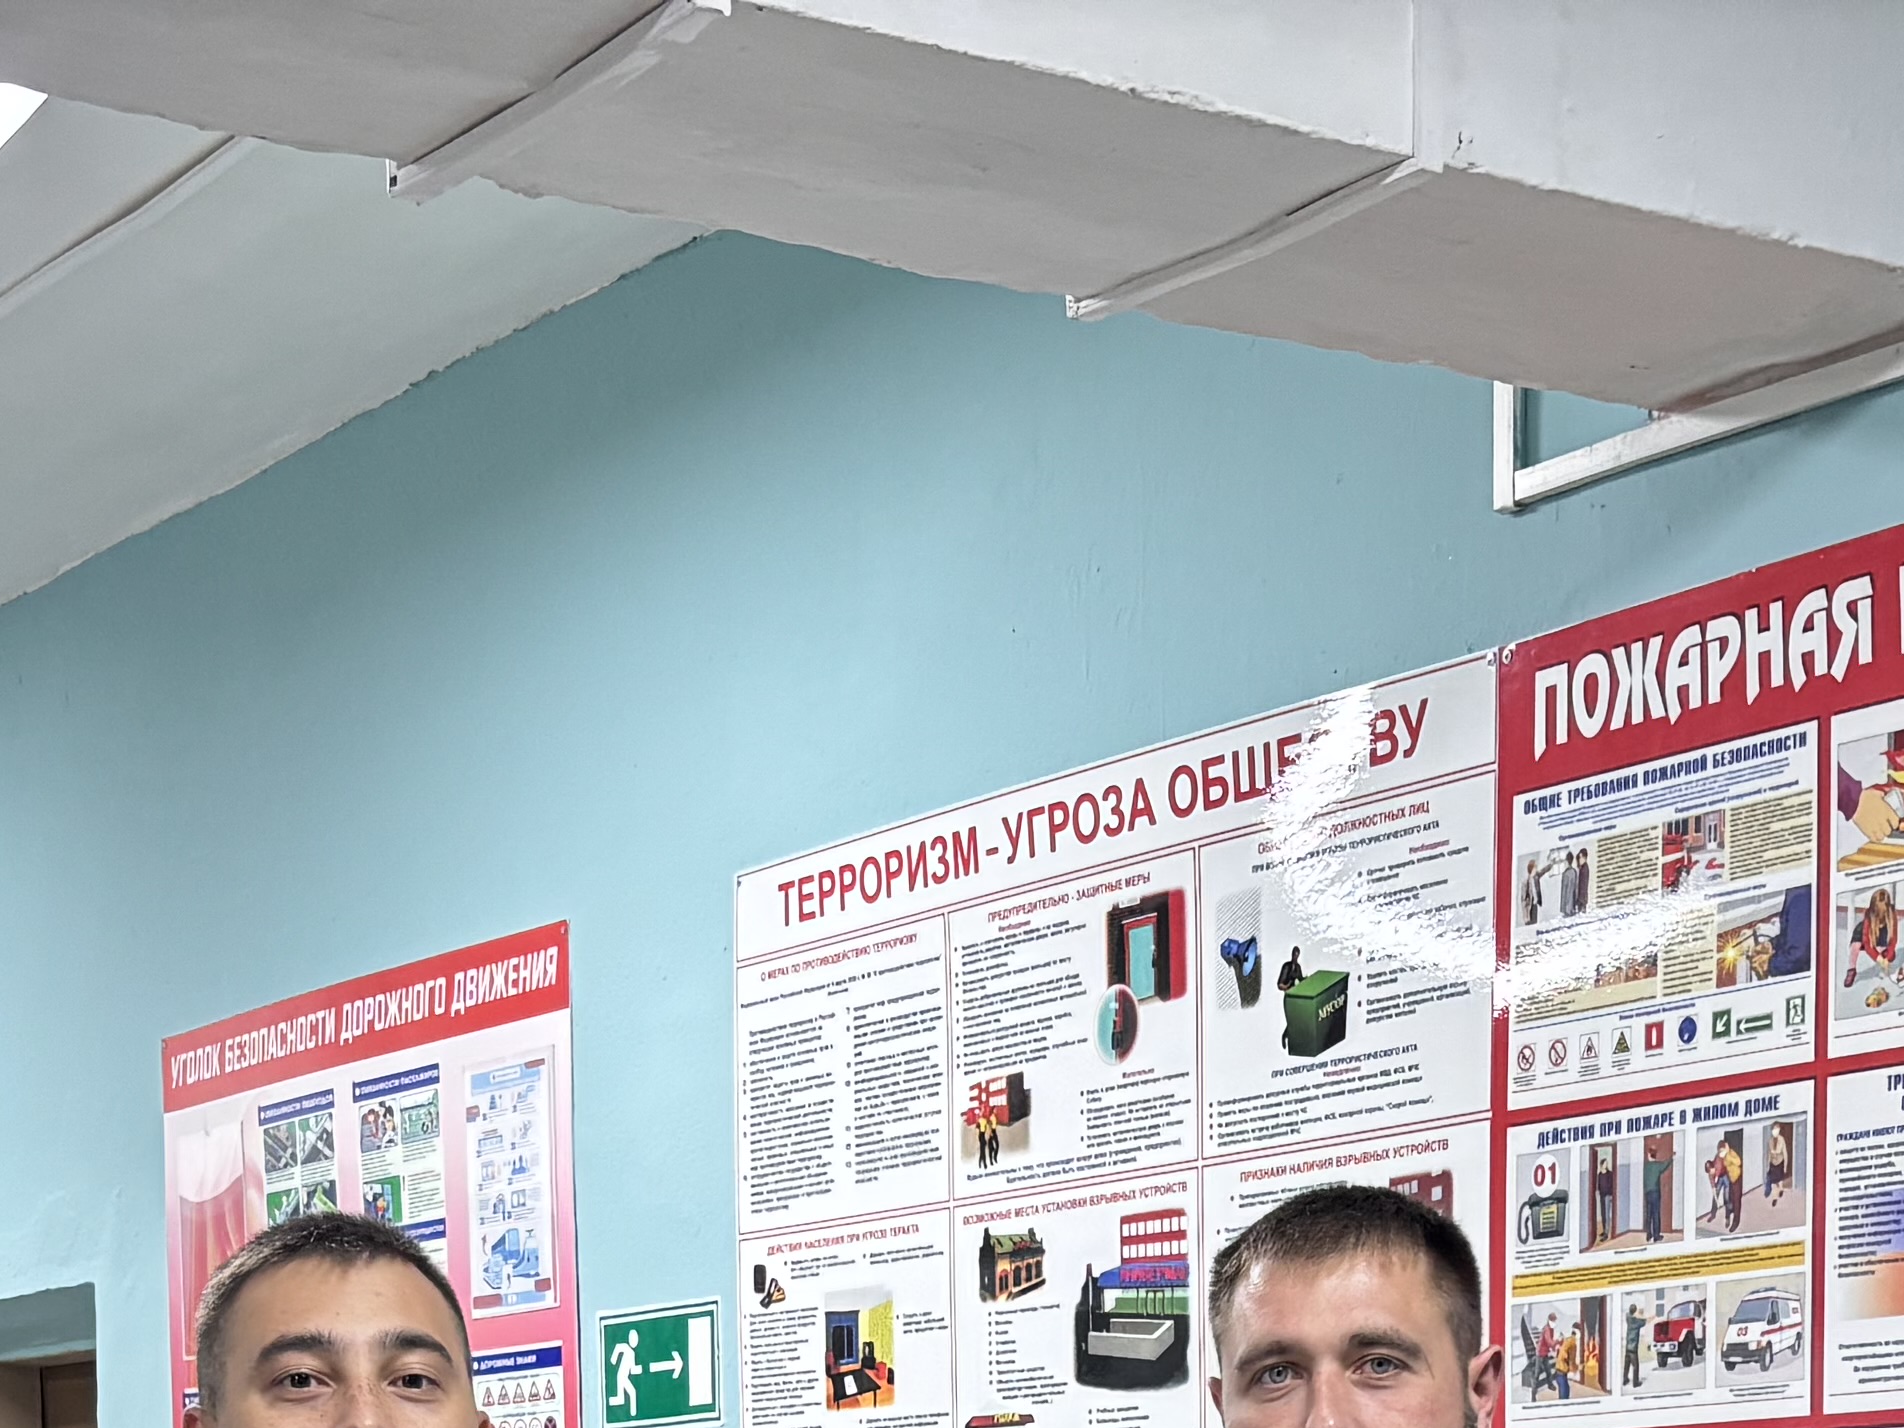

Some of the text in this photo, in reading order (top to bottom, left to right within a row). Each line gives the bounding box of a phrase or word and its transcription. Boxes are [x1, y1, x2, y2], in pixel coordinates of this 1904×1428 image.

[1533, 575, 1875, 762] ПОЖАРНАЯ
[1166, 698, 1429, 820] ОБЩЕВУ
[1524, 731, 1807, 815] ОБЩИЕ ТРЕБОВАНИЯ ПОЖАРНОЙ БЕЗОПАСНОСТИ
[171, 946, 558, 1088] УГОЛОК БЕЗОПАСНОСТИ ДОРОЖНОГО ДВИЖЕНИЯ
[1538, 1122, 1595, 1149] ДЕЙСТВИЯ
[1600, 1120, 1621, 1137] ПРИ
[1627, 1111, 1675, 1134] ПОЖАРЕ
[1692, 1101, 1739, 1123] ЖИЛОМ
[1744, 1095, 1780, 1117] ДОМЕ
[1138, 1182, 1187, 1203] УСТРОЙСТВ
[1241, 1139, 1449, 1182] ПРИЗНАКИ НАЛИЧИЯ ВЗРЫВНЫХ УСТРОЙСТВ
[1534, 1162, 1557, 1186] 01
